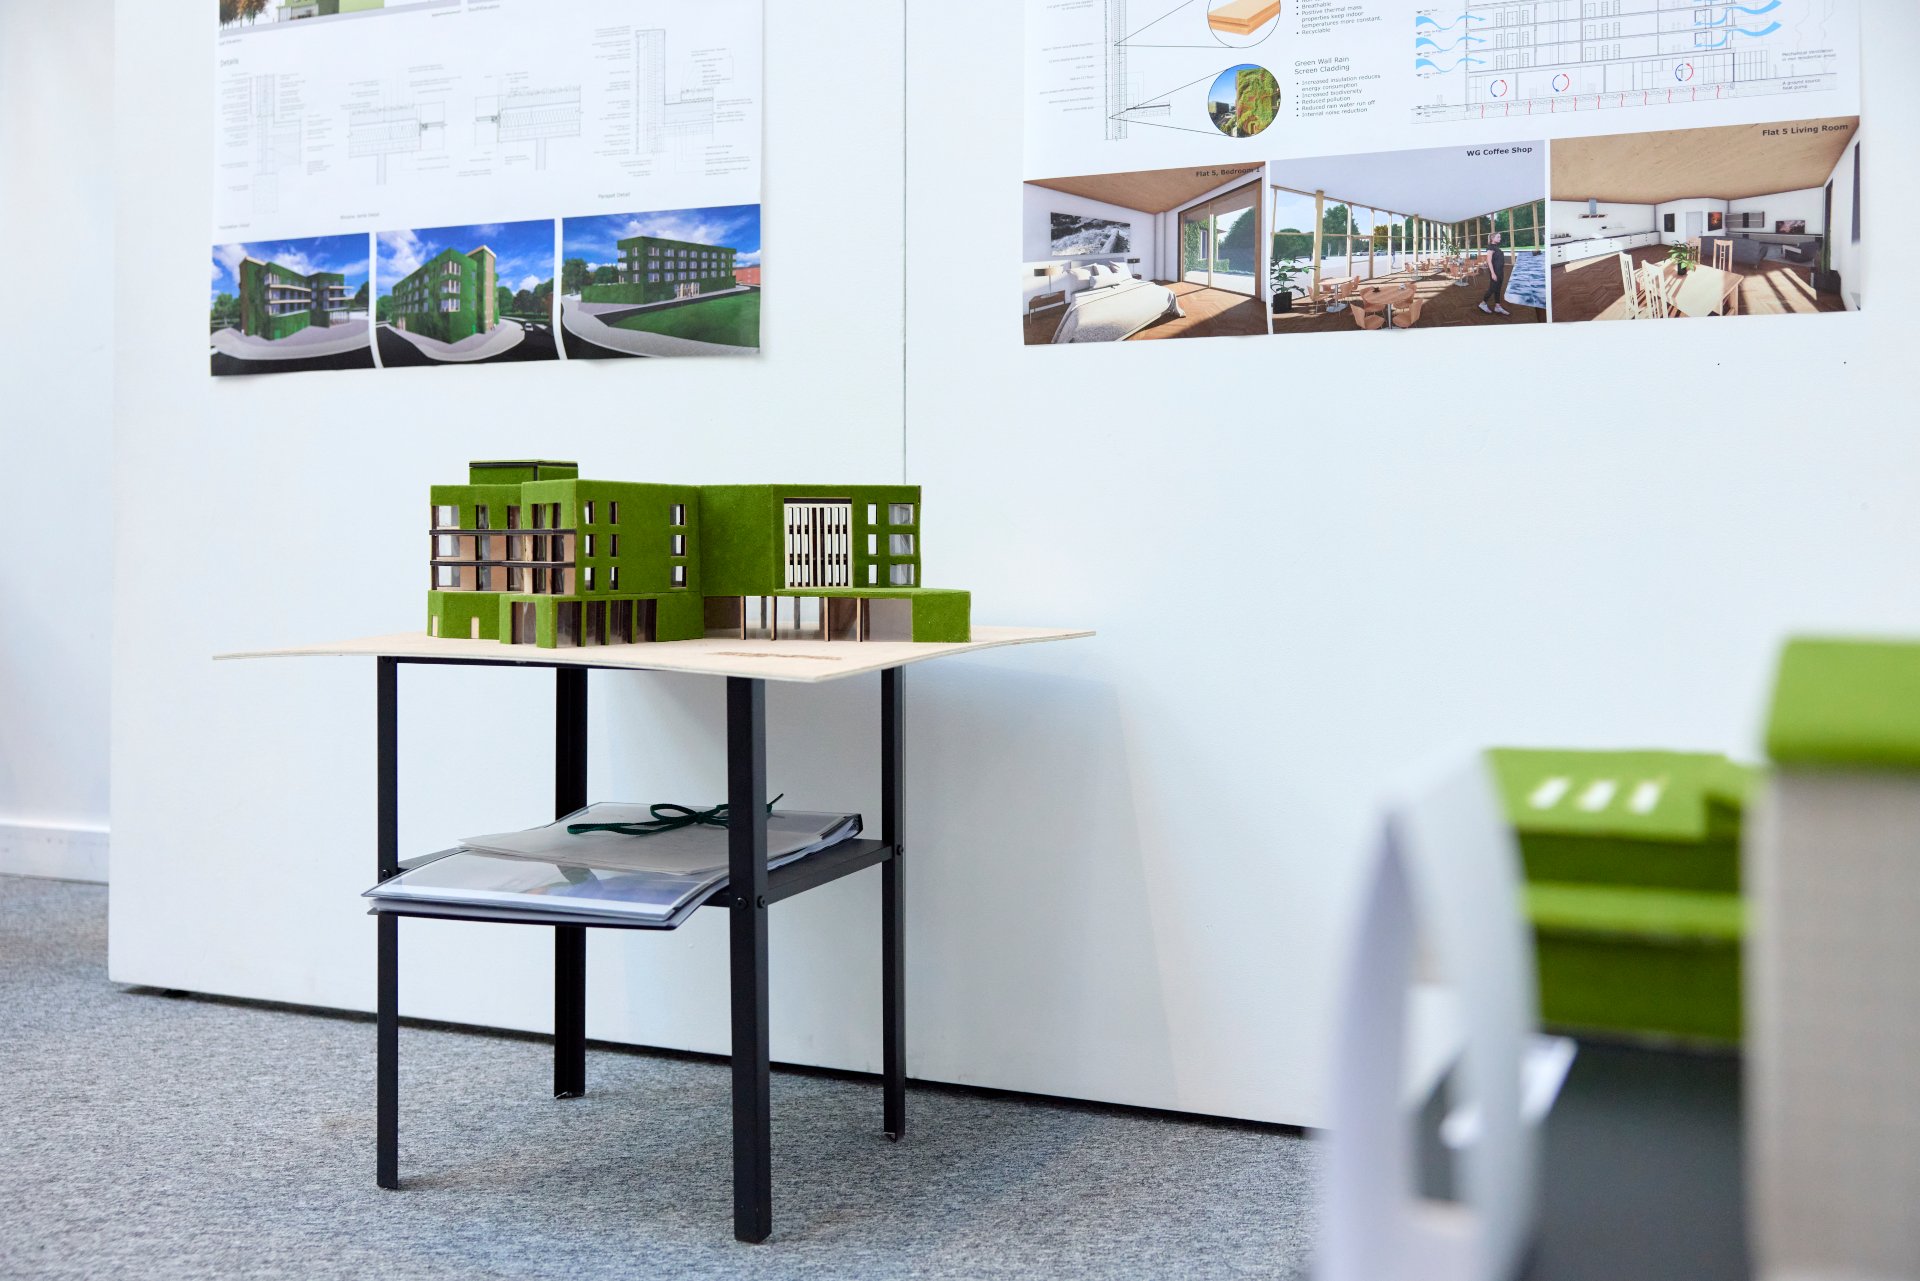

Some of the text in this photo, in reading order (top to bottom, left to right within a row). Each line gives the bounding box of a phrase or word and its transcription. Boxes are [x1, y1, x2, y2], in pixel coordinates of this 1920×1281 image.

[1302, 20, 1338, 28] temperatures
[1319, 64, 1350, 73] Cladding
[1331, 75, 1357, 83] insulation
[1322, 82, 1358, 90] consumption
[1330, 88, 1362, 96] biodiversity
[1791, 126, 1818, 134] Living
[1821, 124, 1849, 132] Room
[1466, 146, 1533, 157] WG Coffee Shop
[1220, 167, 1254, 175] Bedroom
